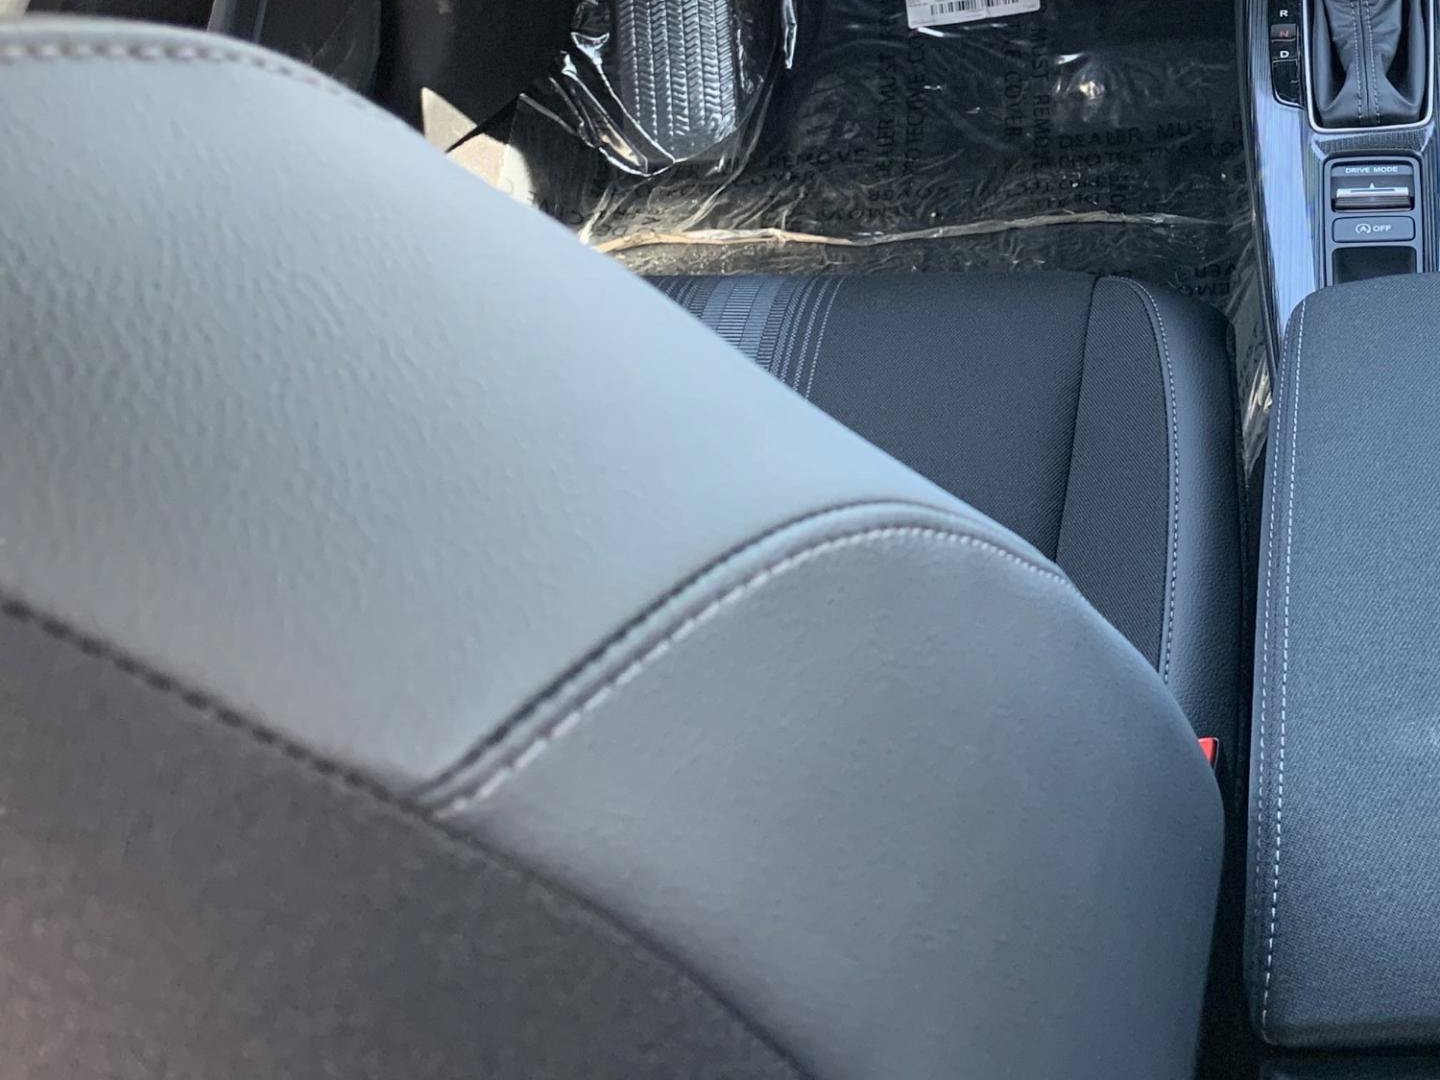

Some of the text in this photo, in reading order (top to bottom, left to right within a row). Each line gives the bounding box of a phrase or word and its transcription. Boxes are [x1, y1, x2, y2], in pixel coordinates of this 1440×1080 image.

[1279, 10, 1289, 18] R
[1280, 50, 1290, 58] D
[1372, 224, 1392, 232] OFF
